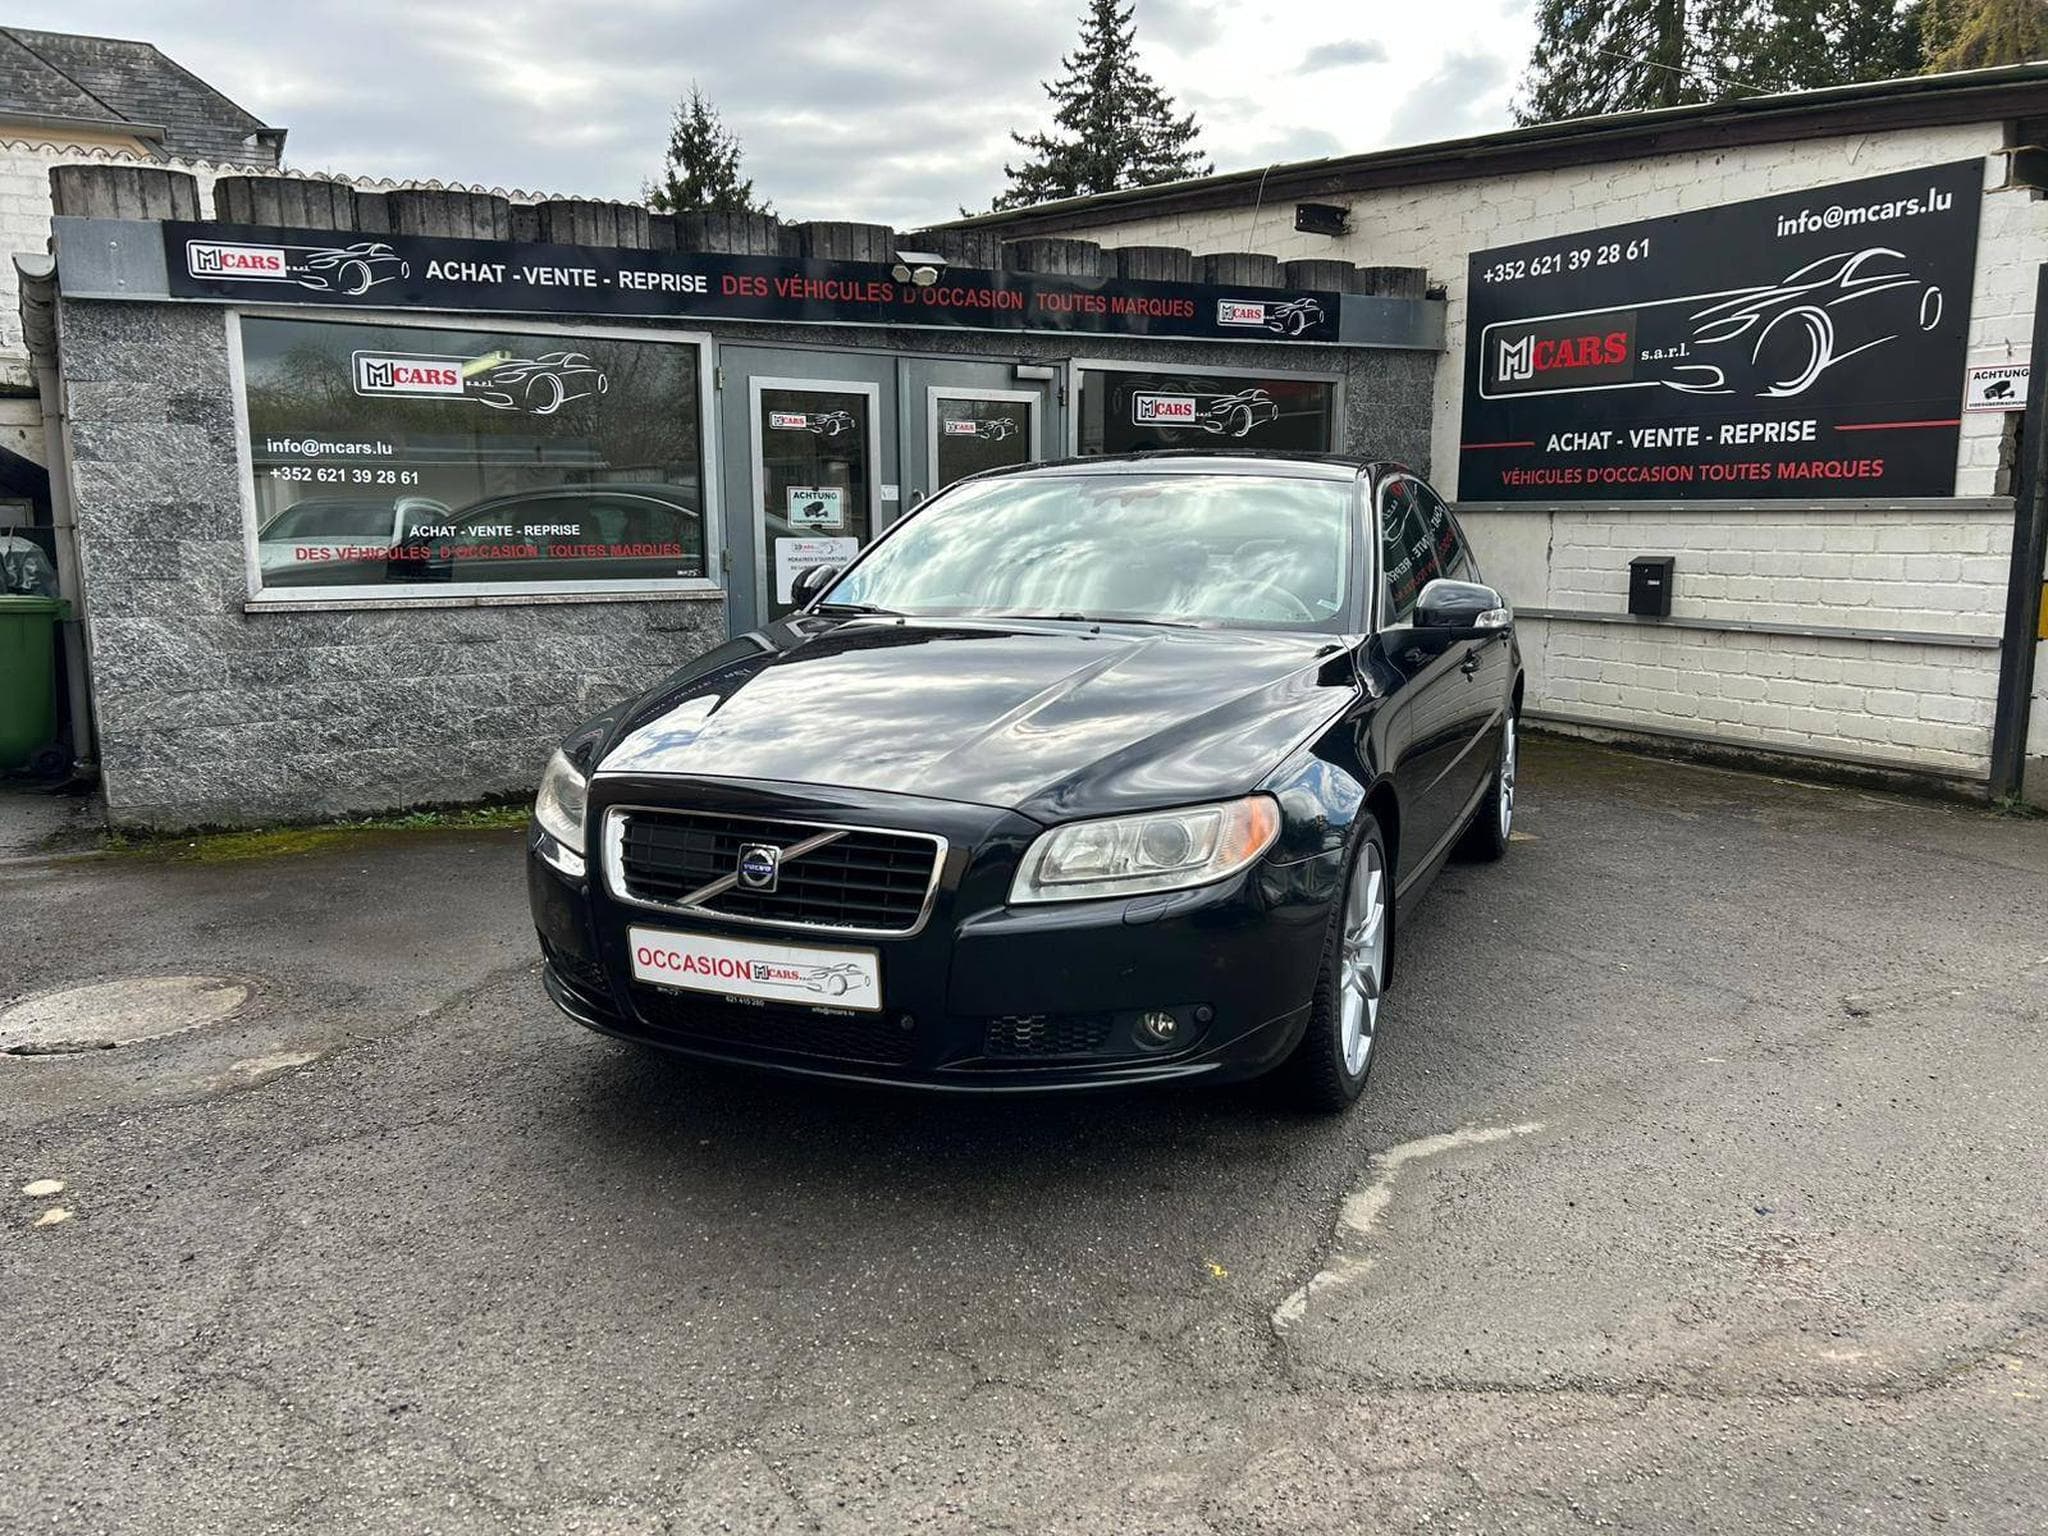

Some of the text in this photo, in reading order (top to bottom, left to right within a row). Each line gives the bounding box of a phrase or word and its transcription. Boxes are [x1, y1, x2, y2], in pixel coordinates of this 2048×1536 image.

[1777, 187, 1952, 237] info@mcars.lu
[1484, 237, 1650, 283] +352 621 39 28 61
[425, 260, 506, 283] ACHAT
[618, 270, 708, 293] REPRISE
[721, 275, 769, 296] DES
[773, 273, 894, 302] VÉHICULES
[903, 285, 1023, 310] D'OCCASION
[1036, 292, 1106, 313] TOUTES
[1111, 296, 1195, 319] MARQUES
[1641, 343, 1691, 361] s.a.r.l.
[1973, 368, 2030, 380] ACHTUNG
[1546, 431, 1613, 452] ACHAT
[1628, 426, 1700, 448] VENTE
[1719, 420, 1818, 445] REPRISE
[266, 438, 393, 457] info@mcars.lu
[270, 467, 419, 485] +352 621 39 28 61
[1501, 459, 1885, 485] VÉHICULES D'OCCASION TOUTES MARQUES
[793, 491, 838, 500] ACHTUNG
[409, 525, 457, 538] ACHAT
[467, 525, 513, 537] VENTE
[524, 524, 580, 536] REPRISE
[295, 547, 331, 560] DES
[336, 544, 432, 560] VÉHICULES
[549, 544, 606, 558] TOUTES
[610, 543, 681, 558] MARQUES
[637, 947, 751, 979] OCCASION
